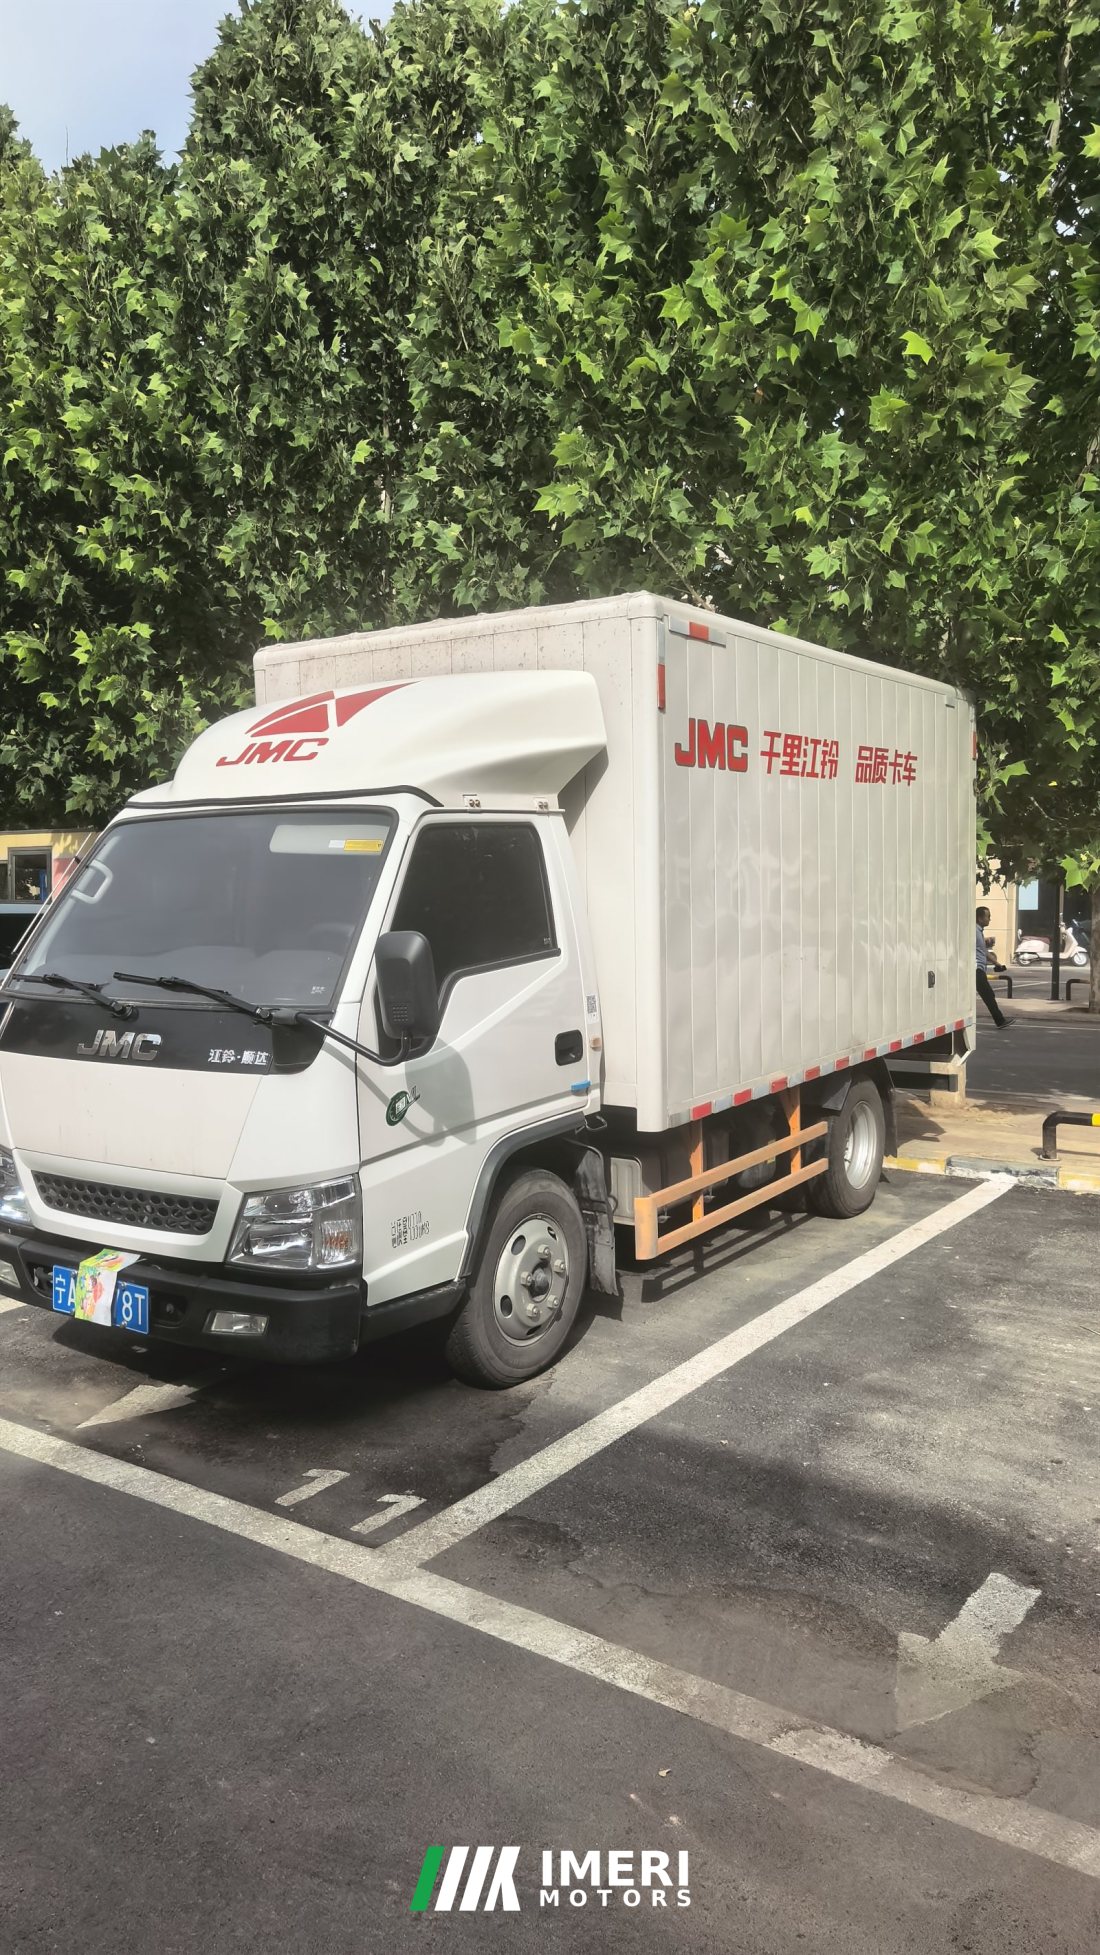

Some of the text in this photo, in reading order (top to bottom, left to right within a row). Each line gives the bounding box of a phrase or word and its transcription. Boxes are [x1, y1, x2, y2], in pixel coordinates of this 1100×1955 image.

[215, 737, 330, 768] JMC
[674, 717, 749, 773] JMC
[854, 745, 918, 787] 品质卡车
[76, 1029, 162, 1061] JMC
